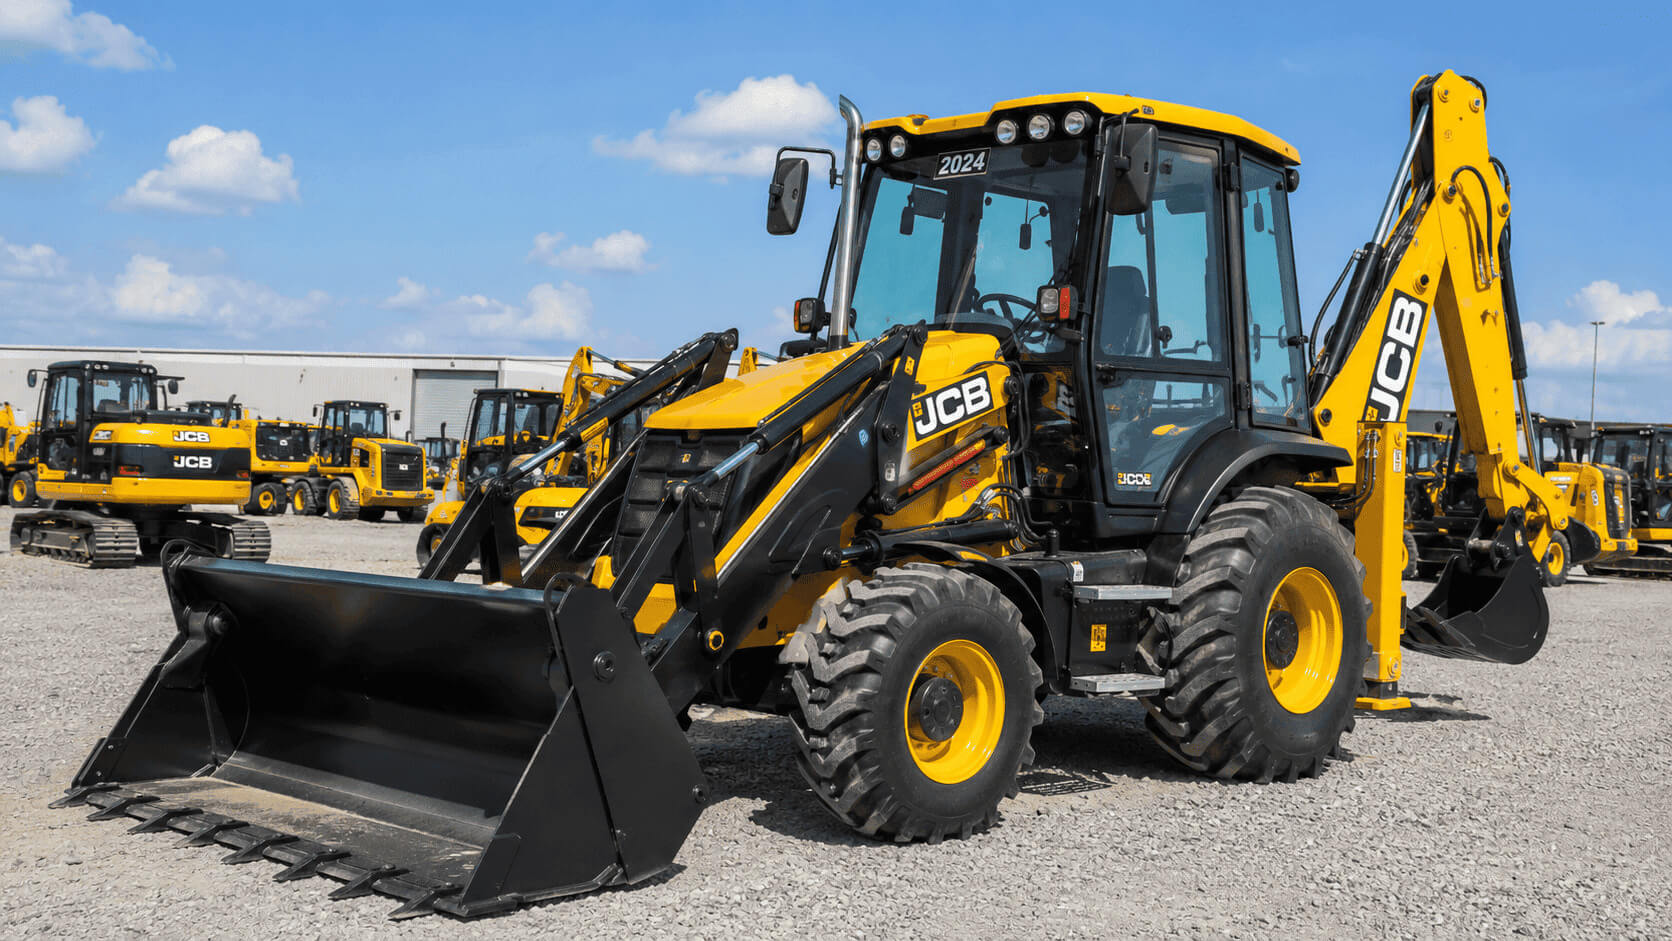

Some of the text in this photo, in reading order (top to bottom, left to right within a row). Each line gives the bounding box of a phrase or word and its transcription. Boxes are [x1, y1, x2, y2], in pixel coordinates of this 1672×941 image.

[938, 151, 986, 175] 2024
[1370, 296, 1423, 422] JCB
[915, 376, 991, 435] JCB
[173, 431, 210, 442] JCB
[173, 455, 213, 469] JCB
